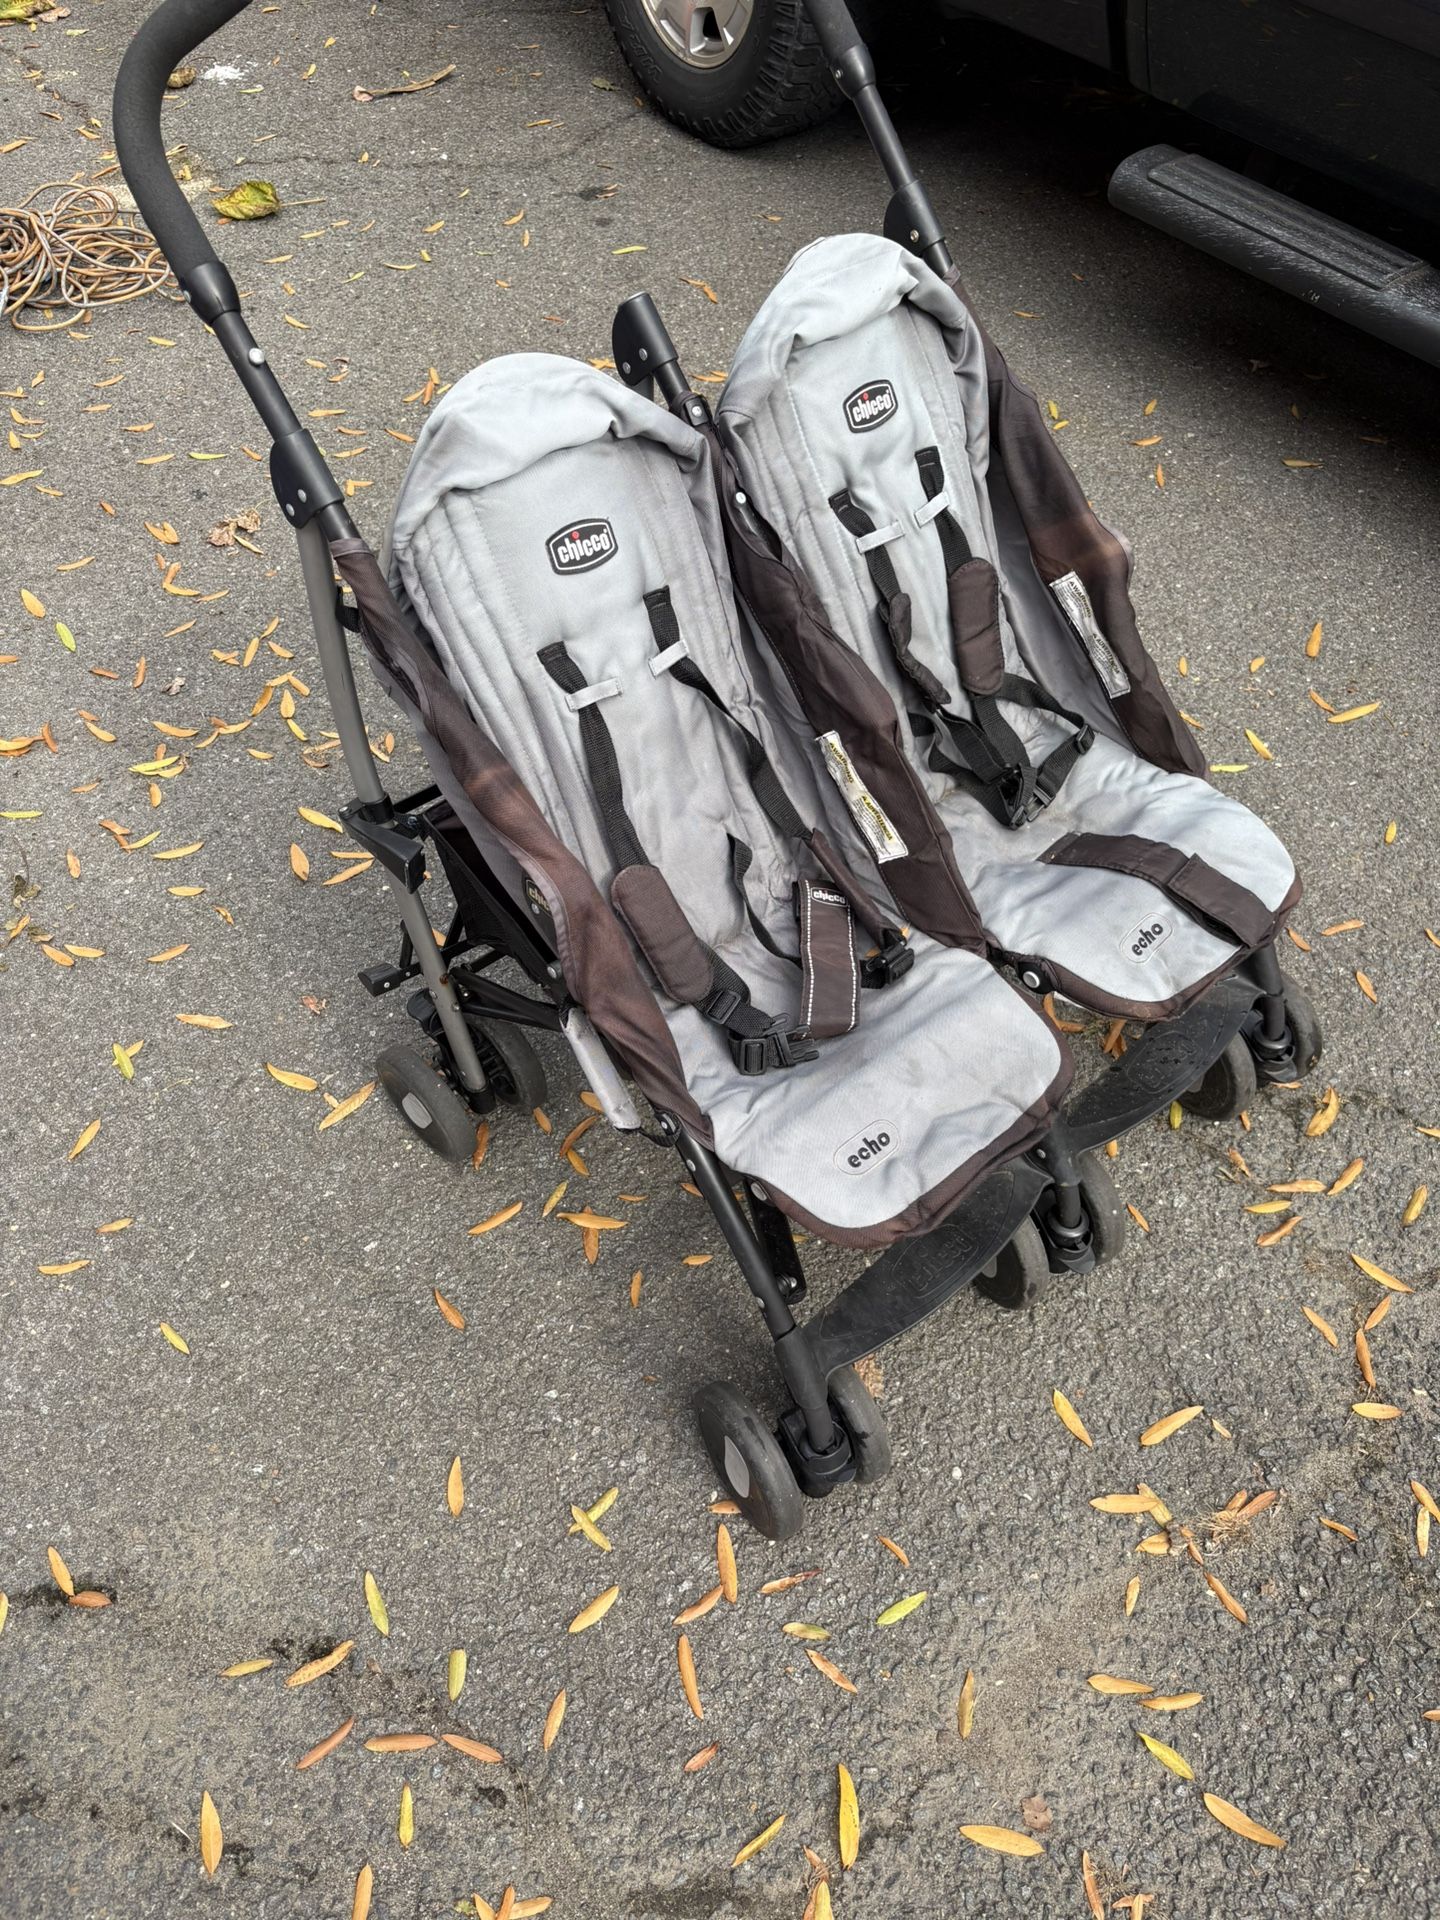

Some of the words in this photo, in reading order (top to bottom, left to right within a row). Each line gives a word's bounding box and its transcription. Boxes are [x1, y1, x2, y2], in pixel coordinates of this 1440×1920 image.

[851, 392, 892, 423] chicco
[557, 530, 611, 564] chicco
[866, 800, 893, 841] ADVERTENCIA
[813, 889, 846, 904] chicco
[1131, 923, 1164, 956] echo
[847, 1131, 891, 1168] echo
